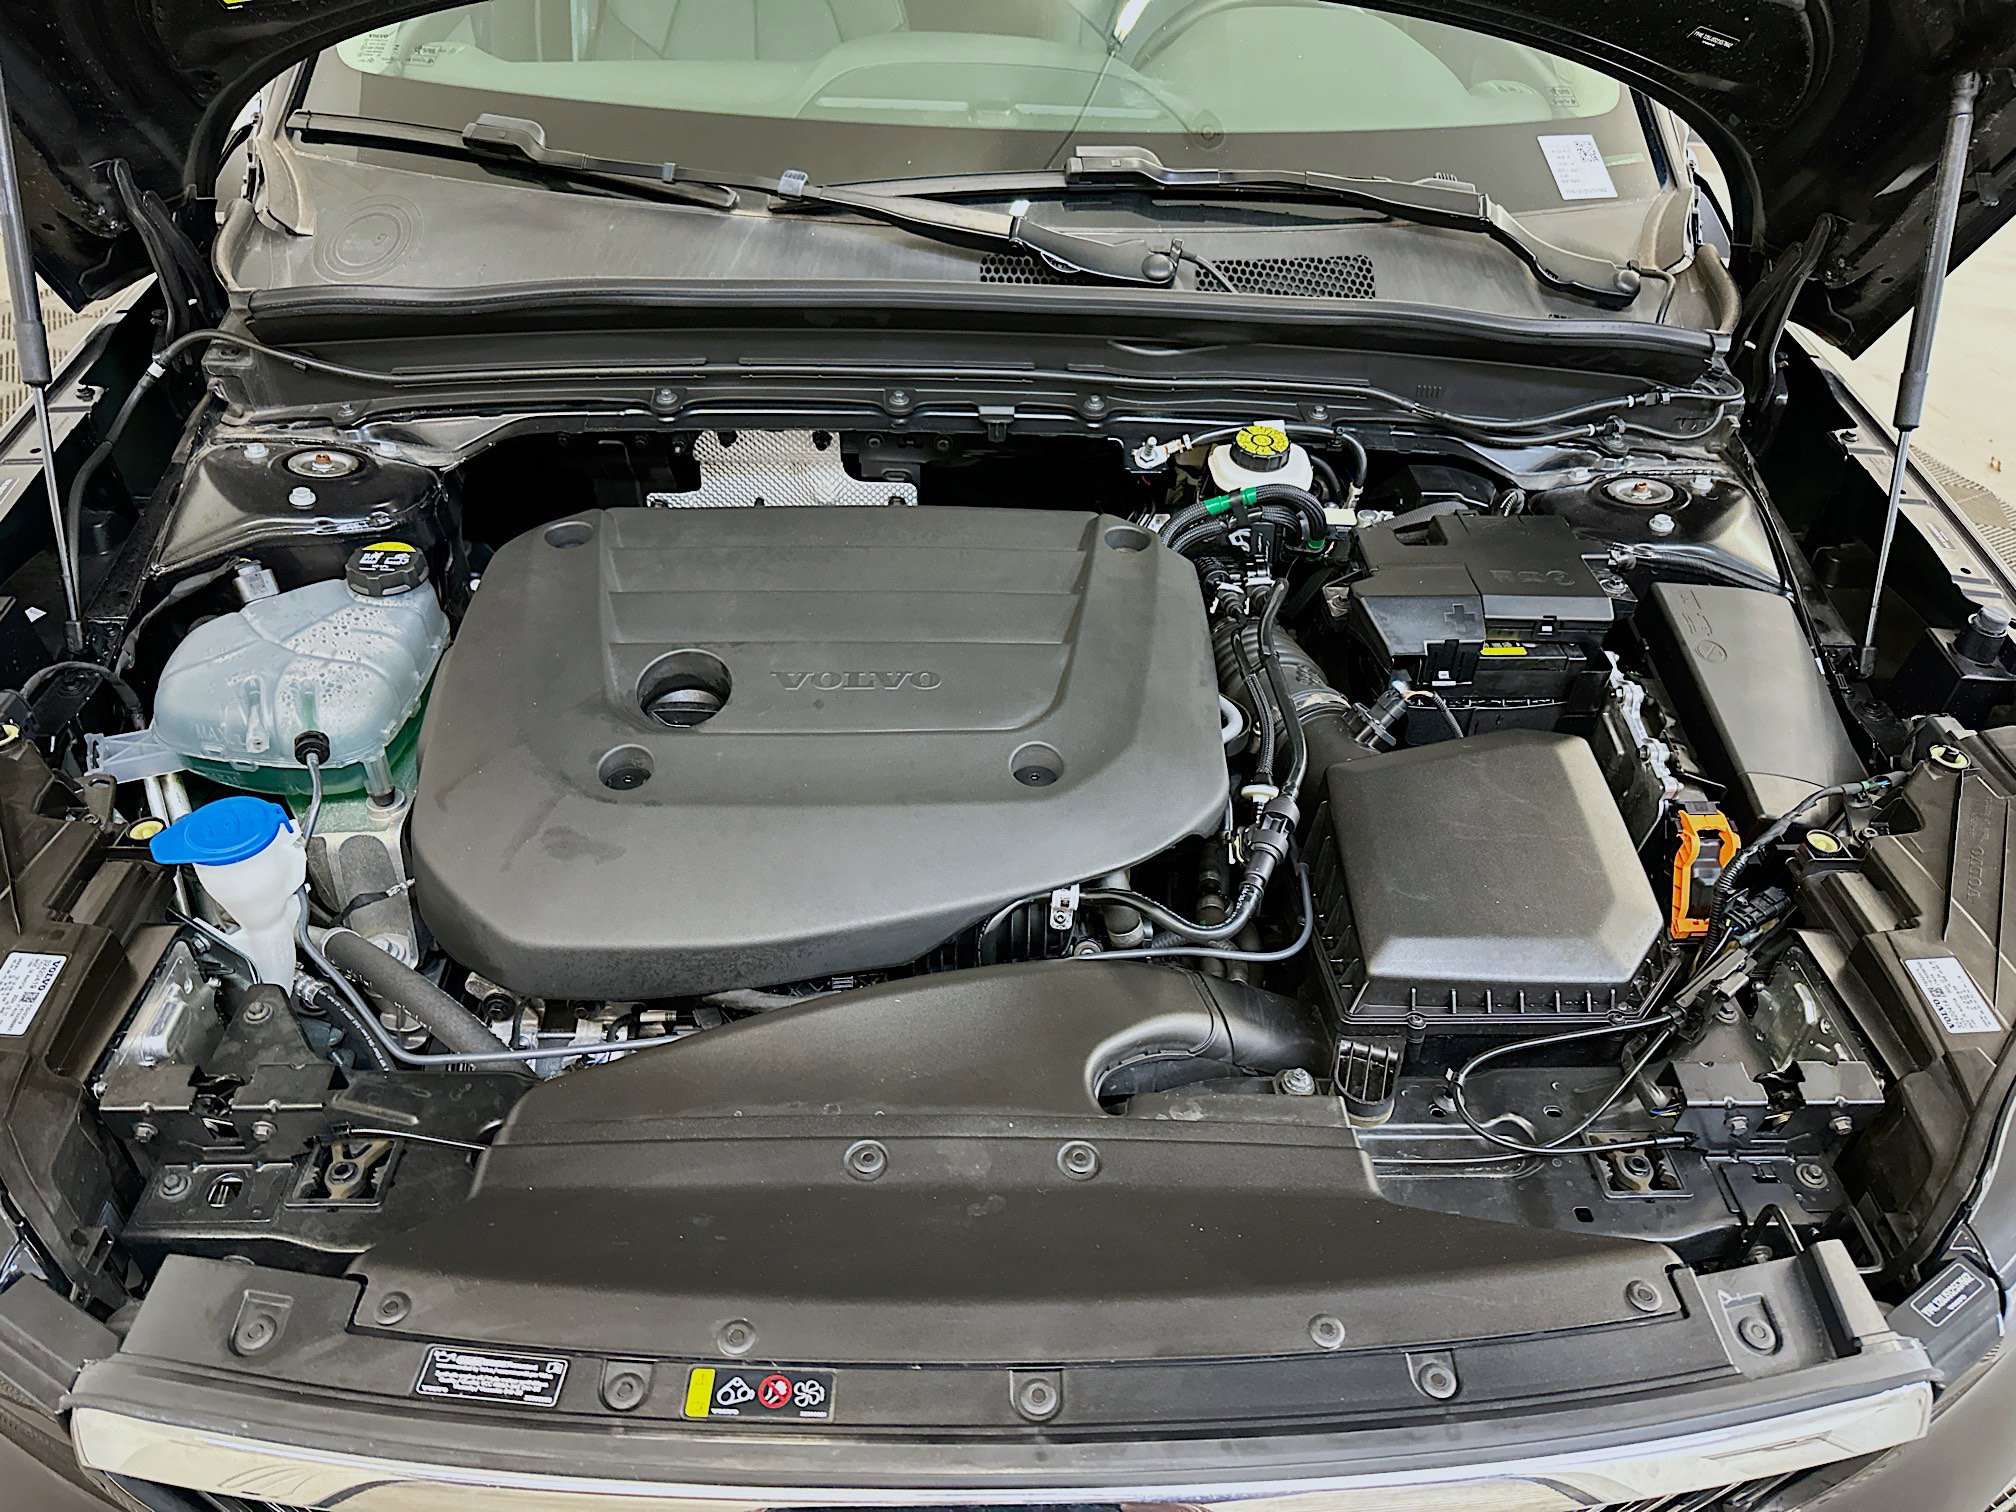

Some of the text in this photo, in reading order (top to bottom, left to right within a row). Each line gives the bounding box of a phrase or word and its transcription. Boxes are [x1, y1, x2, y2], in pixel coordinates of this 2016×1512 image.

[770, 671, 942, 691] VOLVO
[1967, 846, 1985, 900] VOLVO
[38, 959, 62, 991] VOLVO
[1933, 999, 1956, 1029] VOLVO
